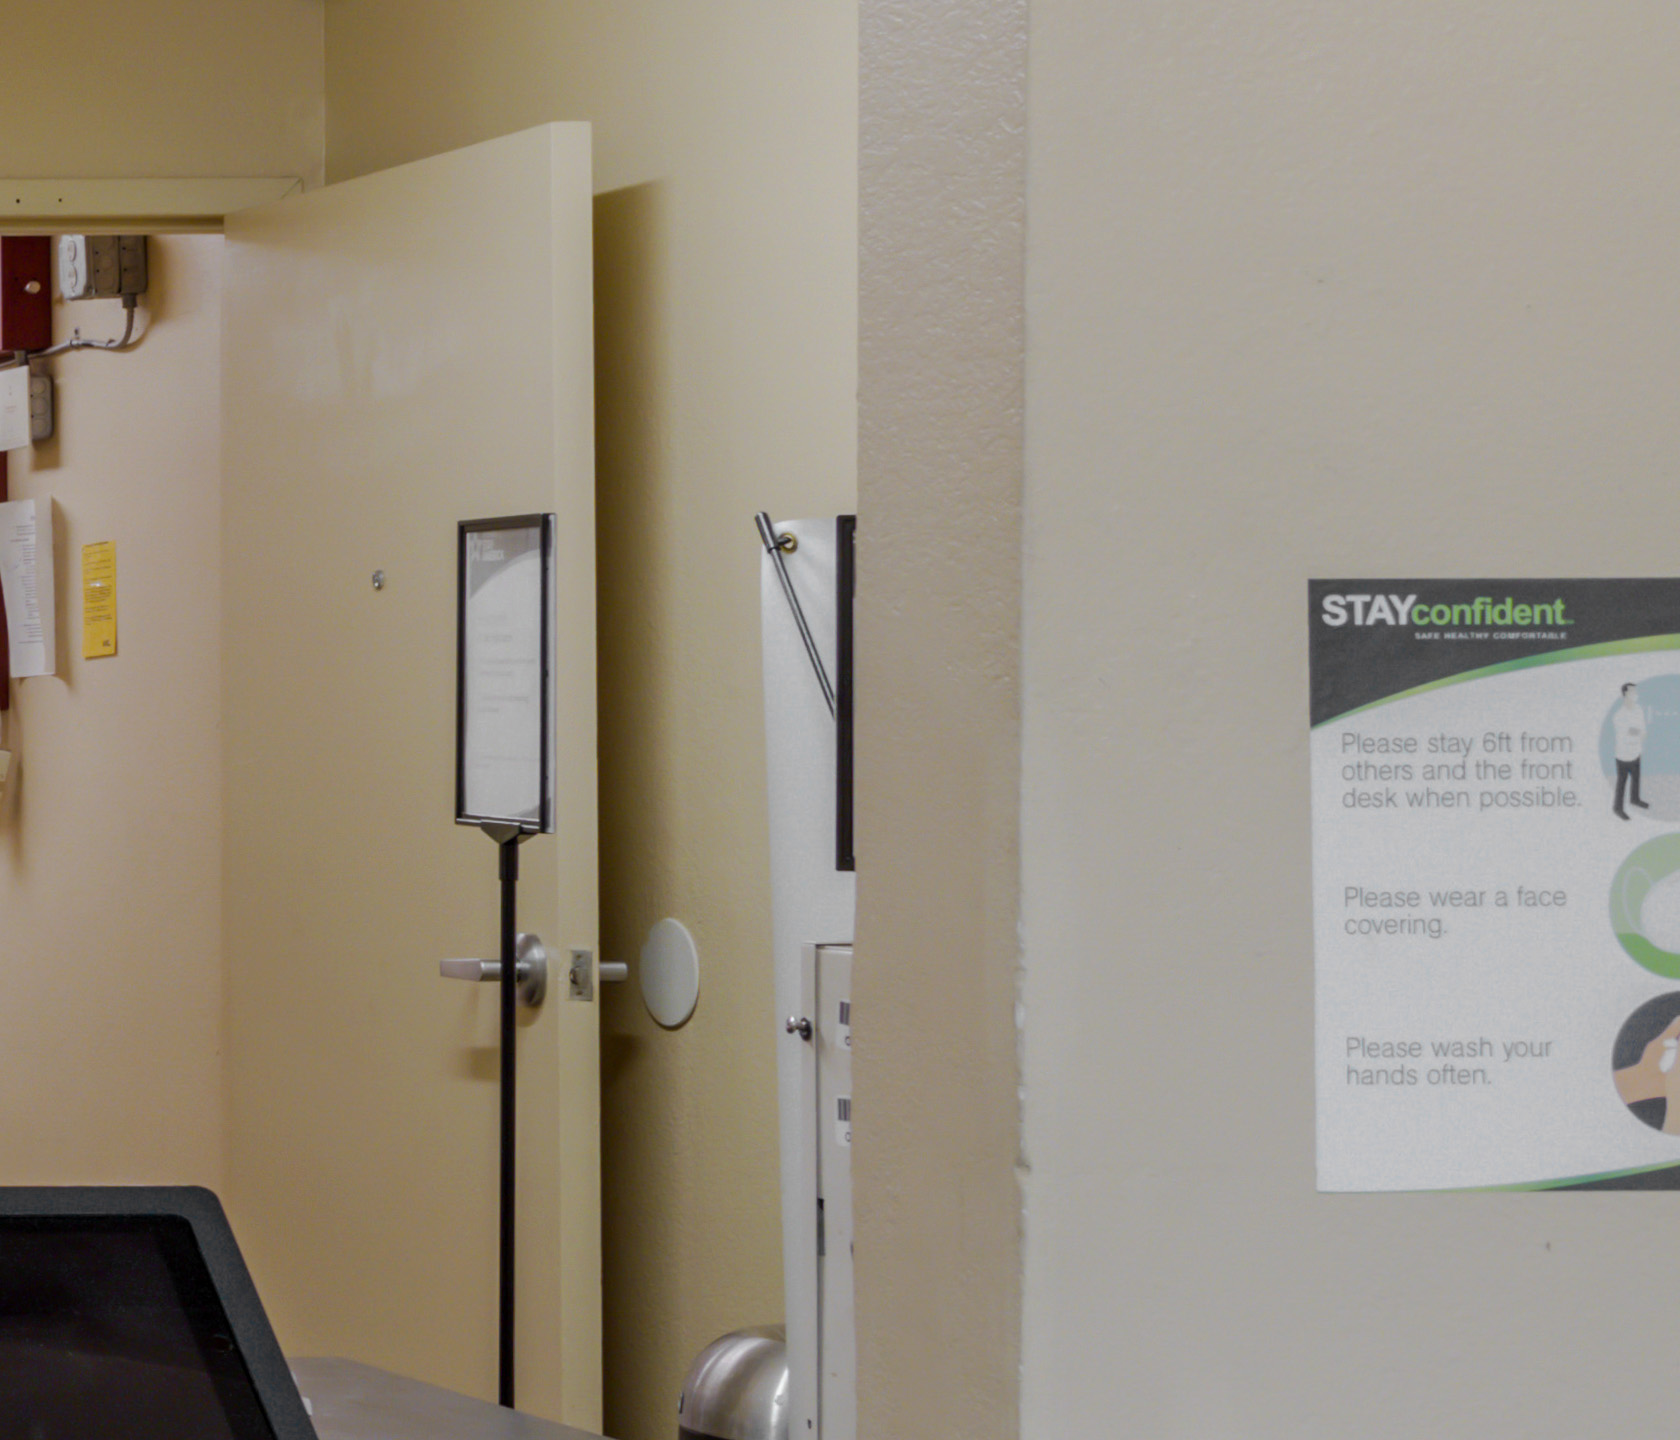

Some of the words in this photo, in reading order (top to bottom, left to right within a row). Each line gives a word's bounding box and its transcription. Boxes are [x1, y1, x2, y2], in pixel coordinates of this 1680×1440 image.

[1414, 631, 1440, 640] SAFE
[1443, 631, 1489, 640] HEALTHY
[1492, 631, 1568, 640] COMFORTABLE
[1341, 732, 1418, 754] Please
[1426, 732, 1474, 758] stay
[1482, 731, 1512, 754] 6ft
[1520, 731, 1573, 754] from
[1341, 760, 1413, 781] others
[1421, 760, 1467, 781] and
[1475, 760, 1511, 780] the
[1521, 759, 1573, 780] front
[1342, 787, 1398, 809] desk
[1405, 787, 1471, 809] when
[1479, 786, 1583, 812] possible.
[1344, 886, 1420, 908] Please
[1429, 890, 1486, 908] wear
[1494, 890, 1509, 907] a
[1516, 886, 1567, 907] face
[1344, 914, 1448, 939] covering.
[1346, 1037, 1422, 1059] Please
[1431, 1037, 1493, 1058] wash
[1502, 1040, 1553, 1062] your
[1346, 1064, 1418, 1086] hands
[1426, 1064, 1492, 1086] often.
